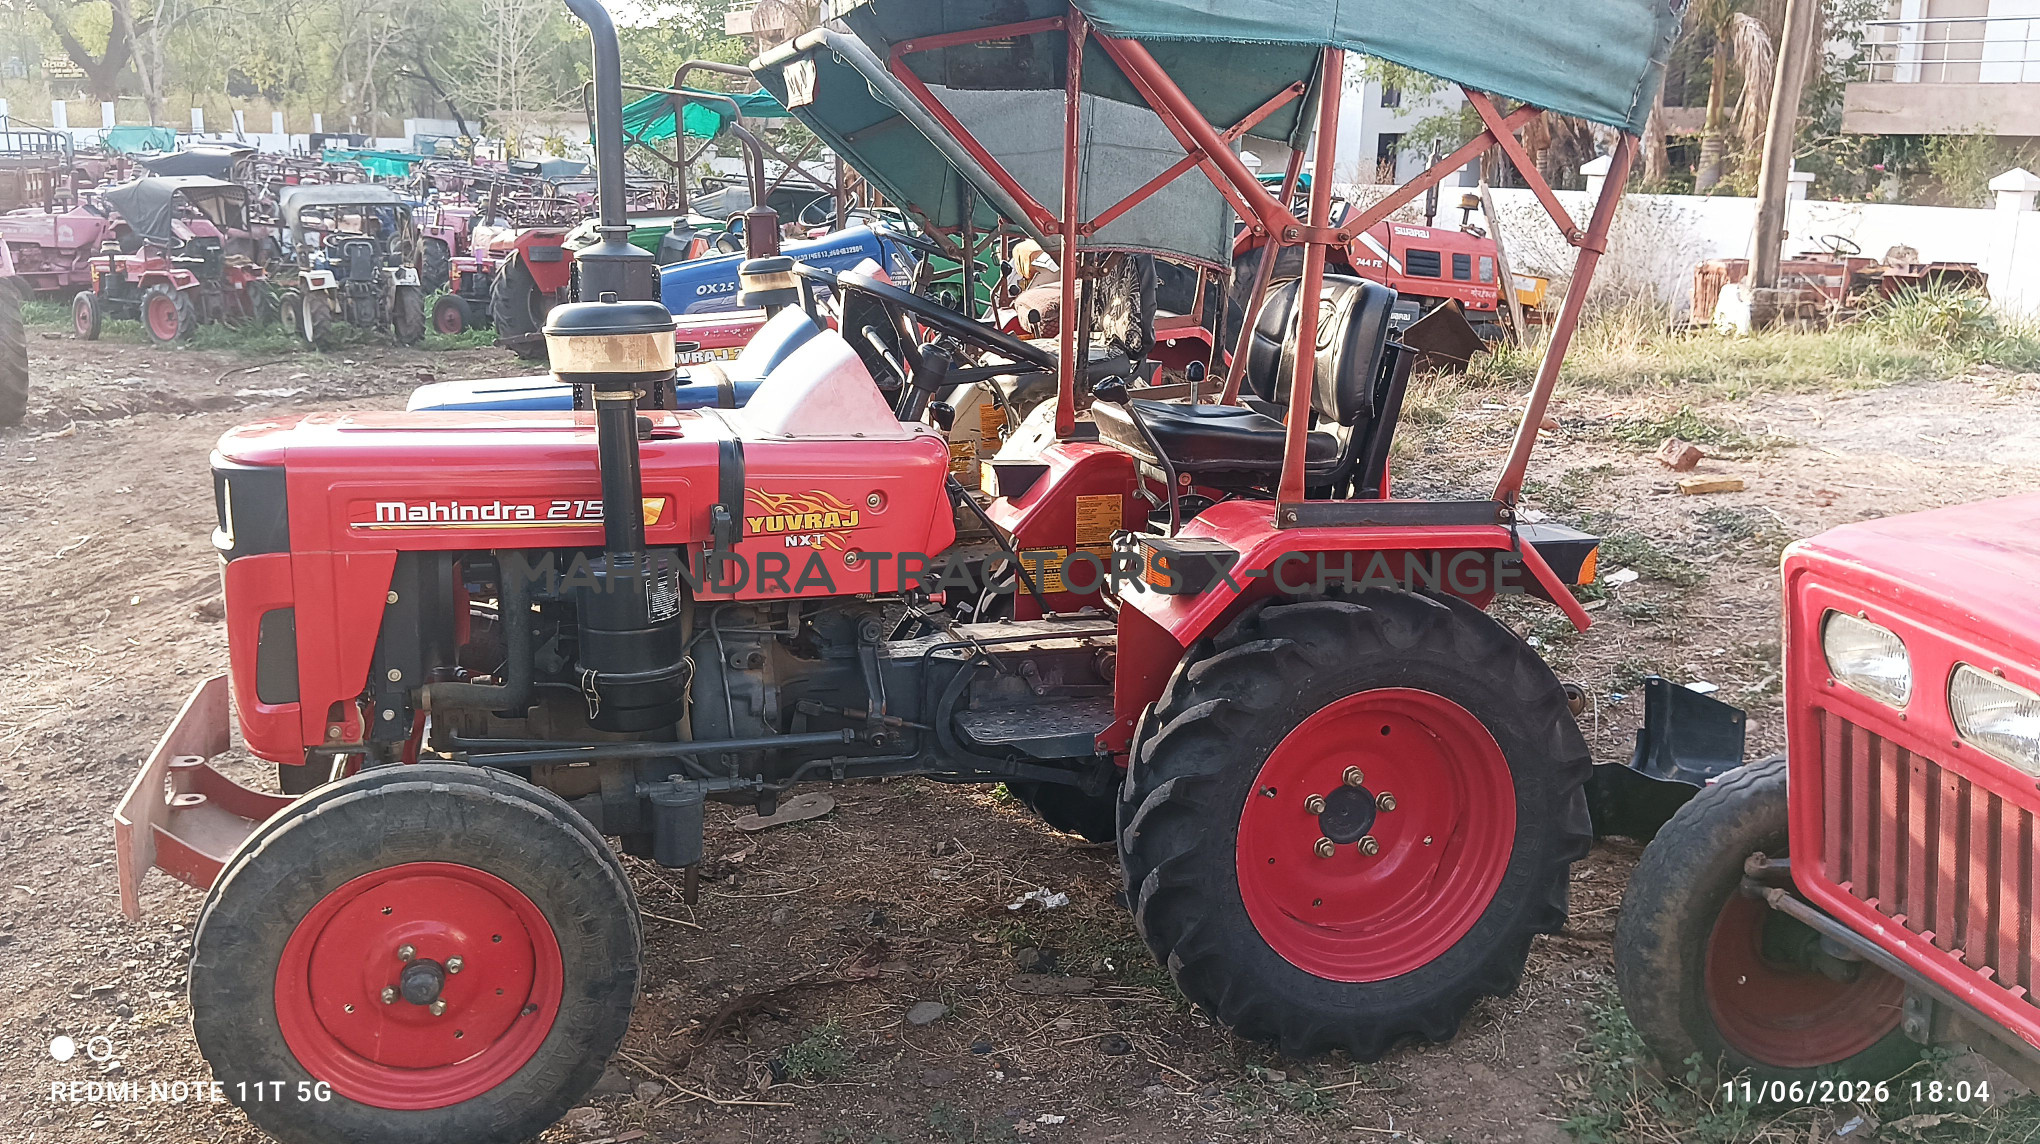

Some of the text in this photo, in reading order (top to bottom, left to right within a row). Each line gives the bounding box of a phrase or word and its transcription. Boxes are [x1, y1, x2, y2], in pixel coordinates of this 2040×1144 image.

[1356, 257, 1383, 268] 744 FE
[375, 501, 604, 522] Mahindra 215
[746, 510, 859, 533] YUVRAJ
[784, 533, 825, 547] NXT
